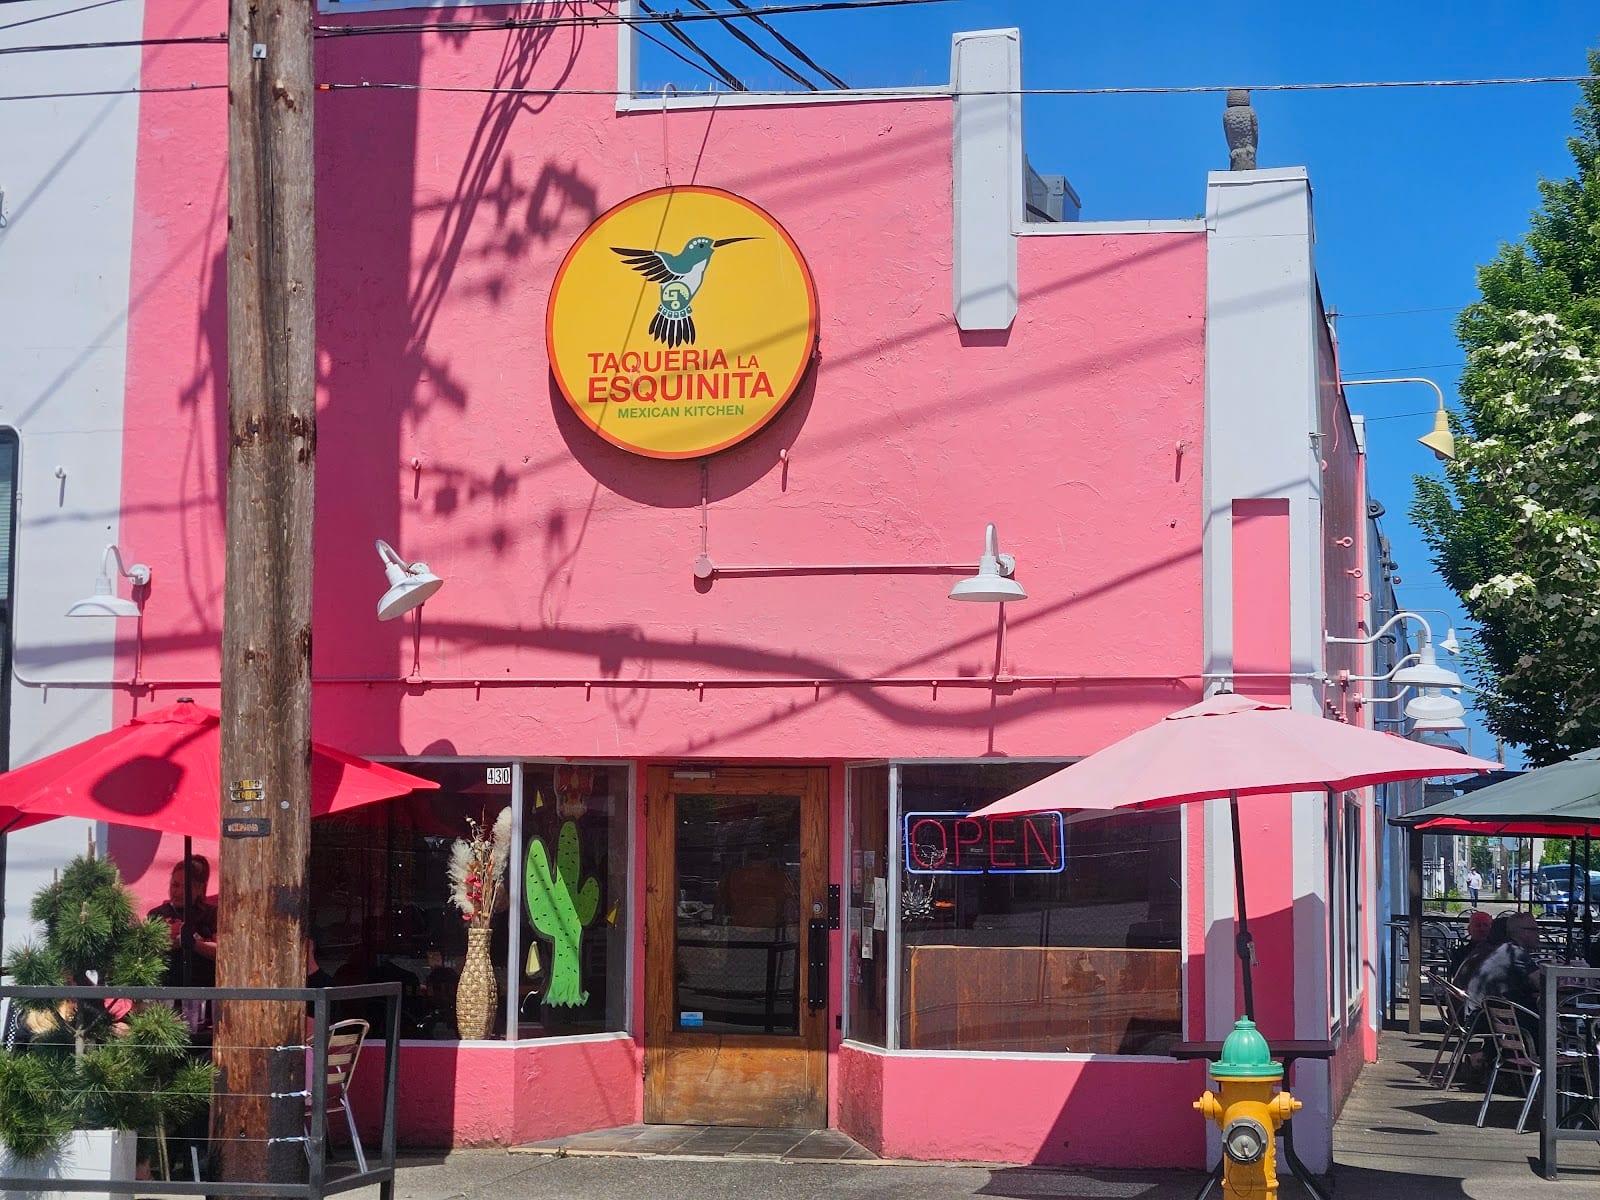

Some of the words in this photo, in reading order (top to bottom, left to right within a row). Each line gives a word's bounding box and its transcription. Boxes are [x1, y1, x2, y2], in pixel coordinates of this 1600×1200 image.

[587, 349, 729, 374] TAQUERIA
[737, 355, 760, 370] LA
[587, 372, 775, 403] ESQUINITA
[617, 407, 680, 419] MEXICAN
[684, 405, 745, 417] KITCHEN
[488, 768, 510, 784] 430
[911, 818, 1057, 867] OPEN
